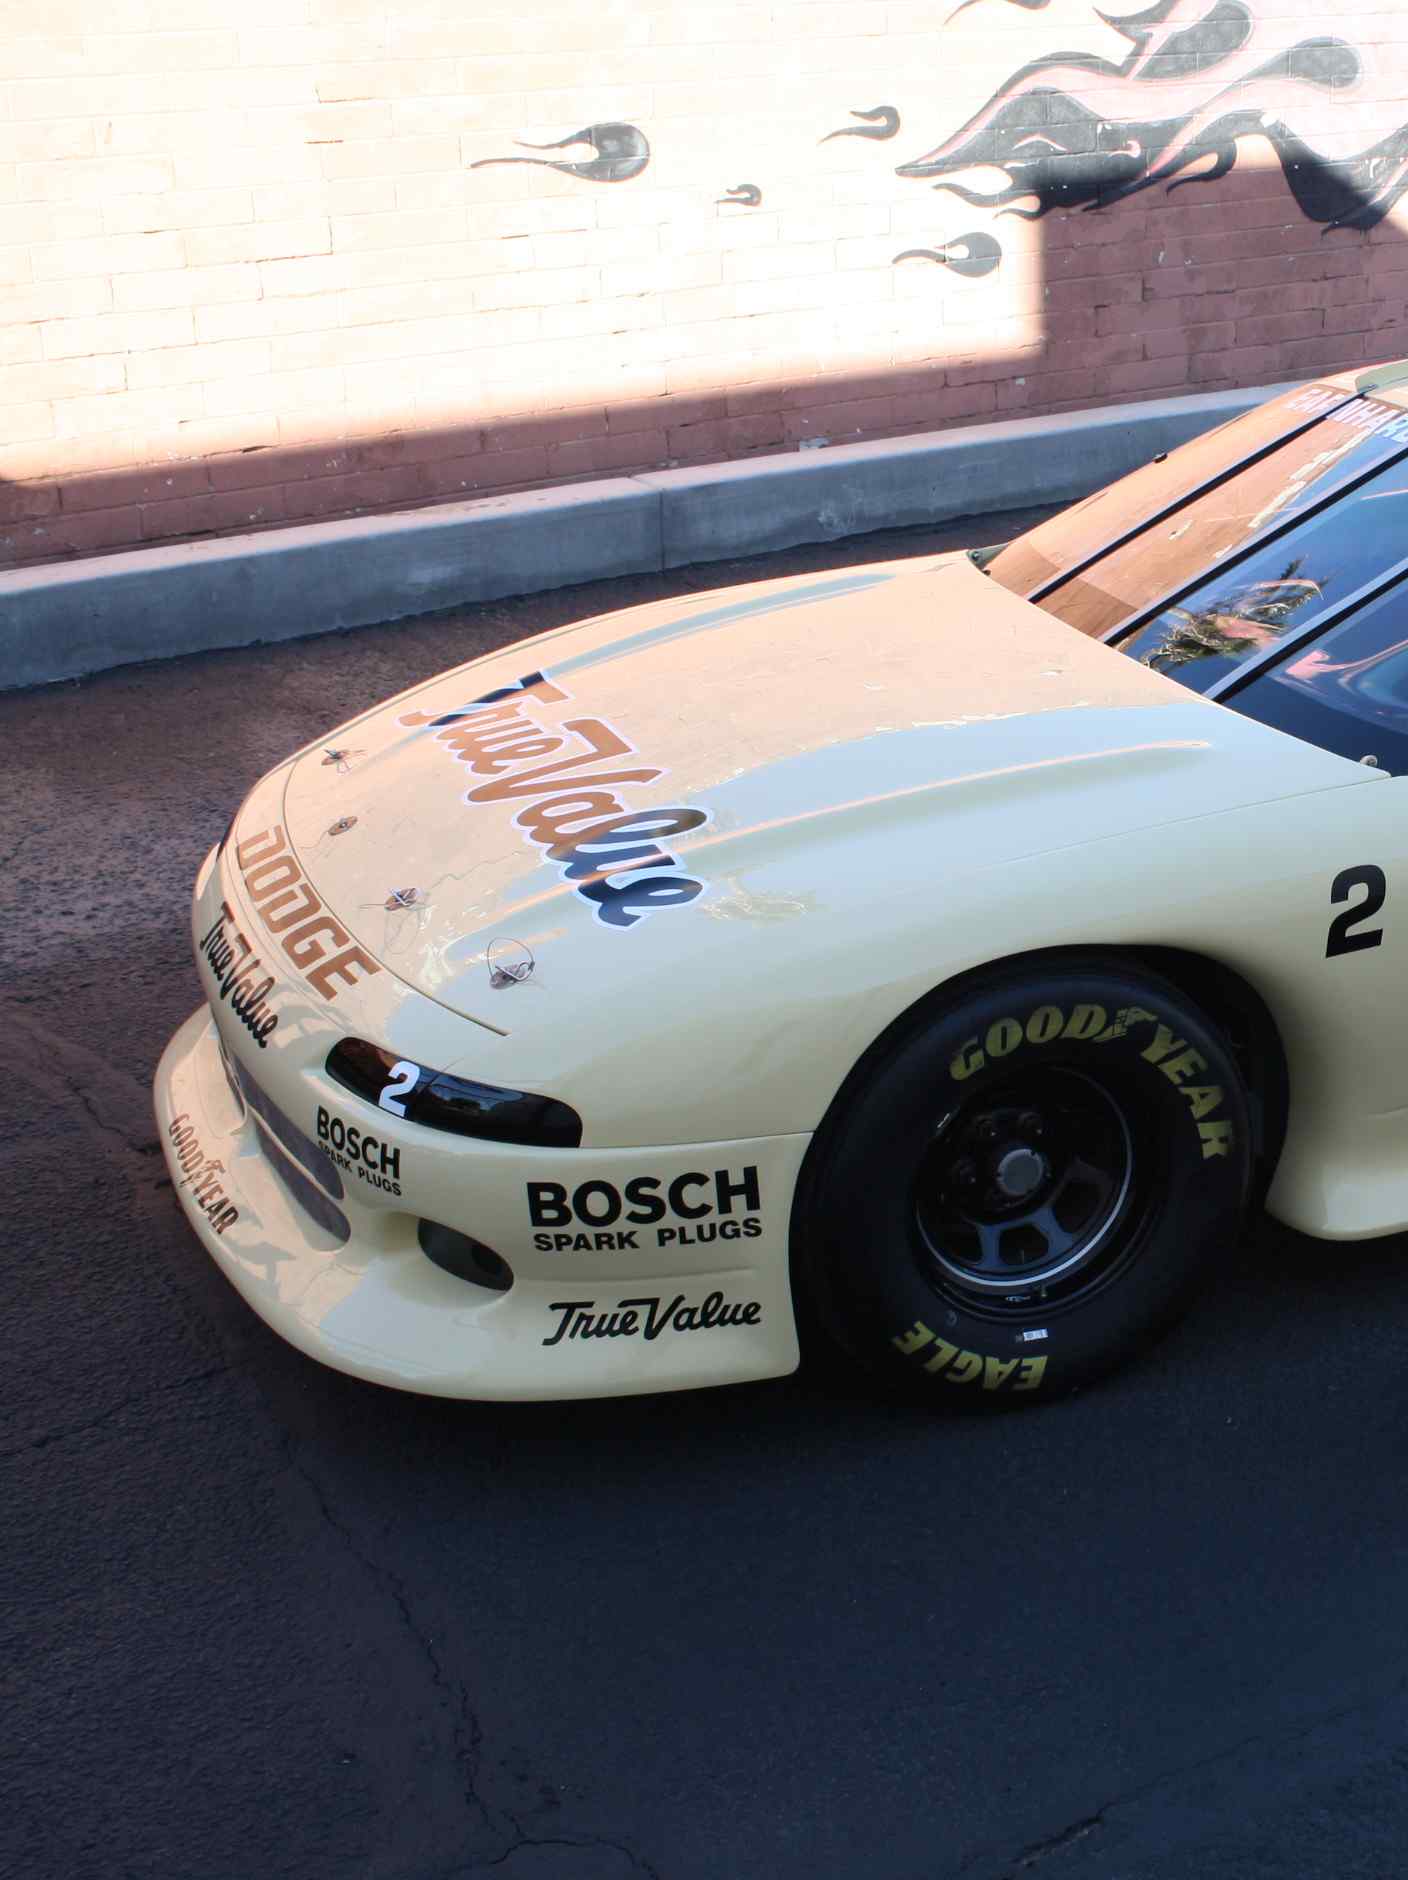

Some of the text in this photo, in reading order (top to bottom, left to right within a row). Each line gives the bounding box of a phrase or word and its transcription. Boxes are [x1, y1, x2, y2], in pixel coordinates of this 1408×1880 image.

[235, 824, 383, 1001] DODGE
[1326, 864, 1387, 959] 2
[378, 1061, 421, 1118] 2
[317, 1105, 401, 1180] BOSCH
[357, 1166, 402, 1197] PLUGS
[526, 1165, 760, 1227] BOSCH
[534, 1217, 762, 1252] SPARK PLUGS
[893, 1320, 1049, 1391] EAGLE
